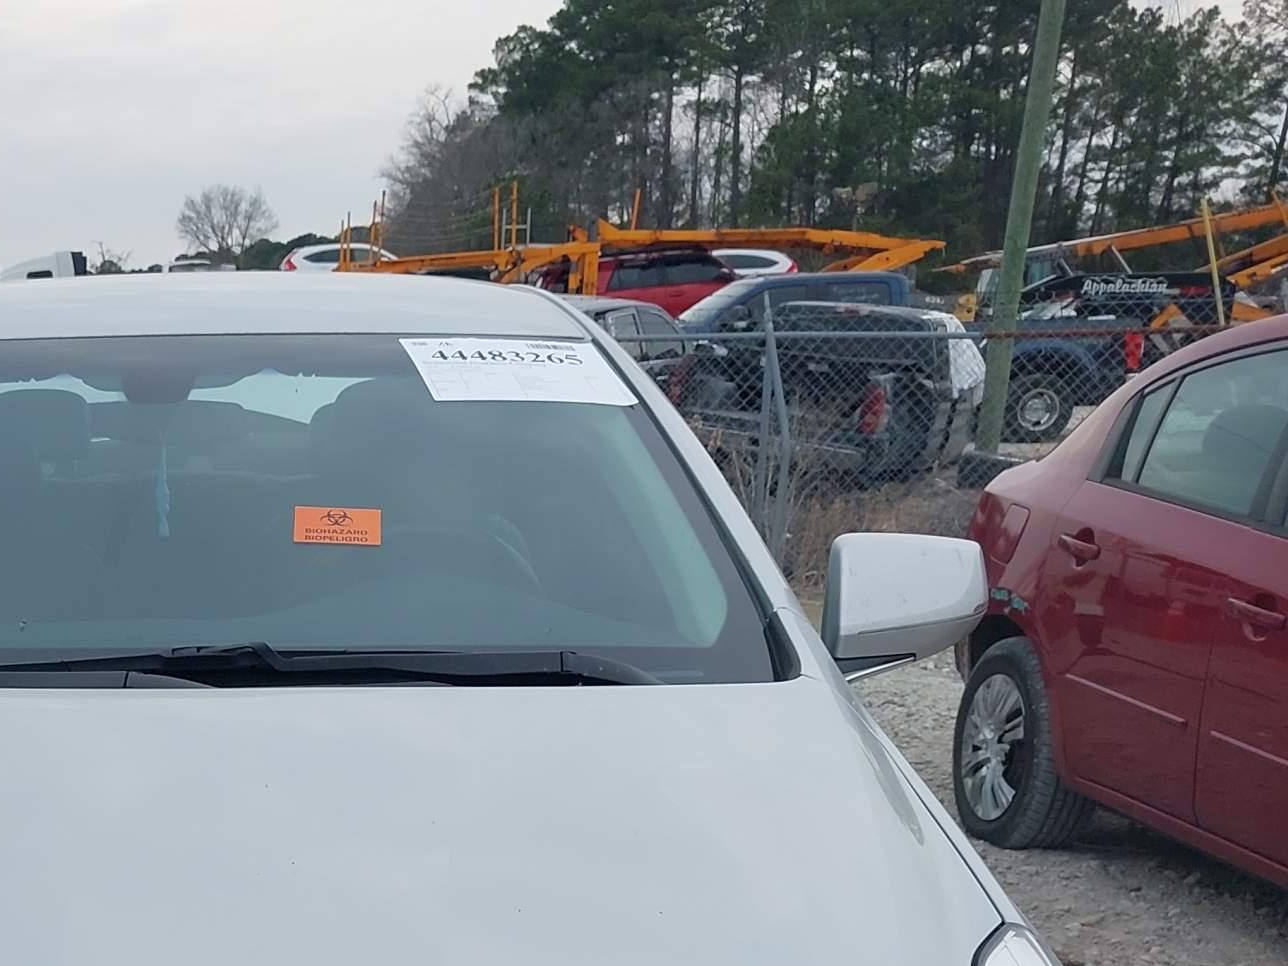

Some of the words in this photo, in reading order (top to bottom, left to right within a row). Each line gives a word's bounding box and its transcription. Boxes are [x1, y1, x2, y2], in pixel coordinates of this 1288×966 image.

[1081, 279, 1168, 296] Appalachian
[431, 349, 584, 366] 44483265
[304, 527, 368, 536] BIOHAZARD
[304, 535, 369, 543] BIOPELIGRO
